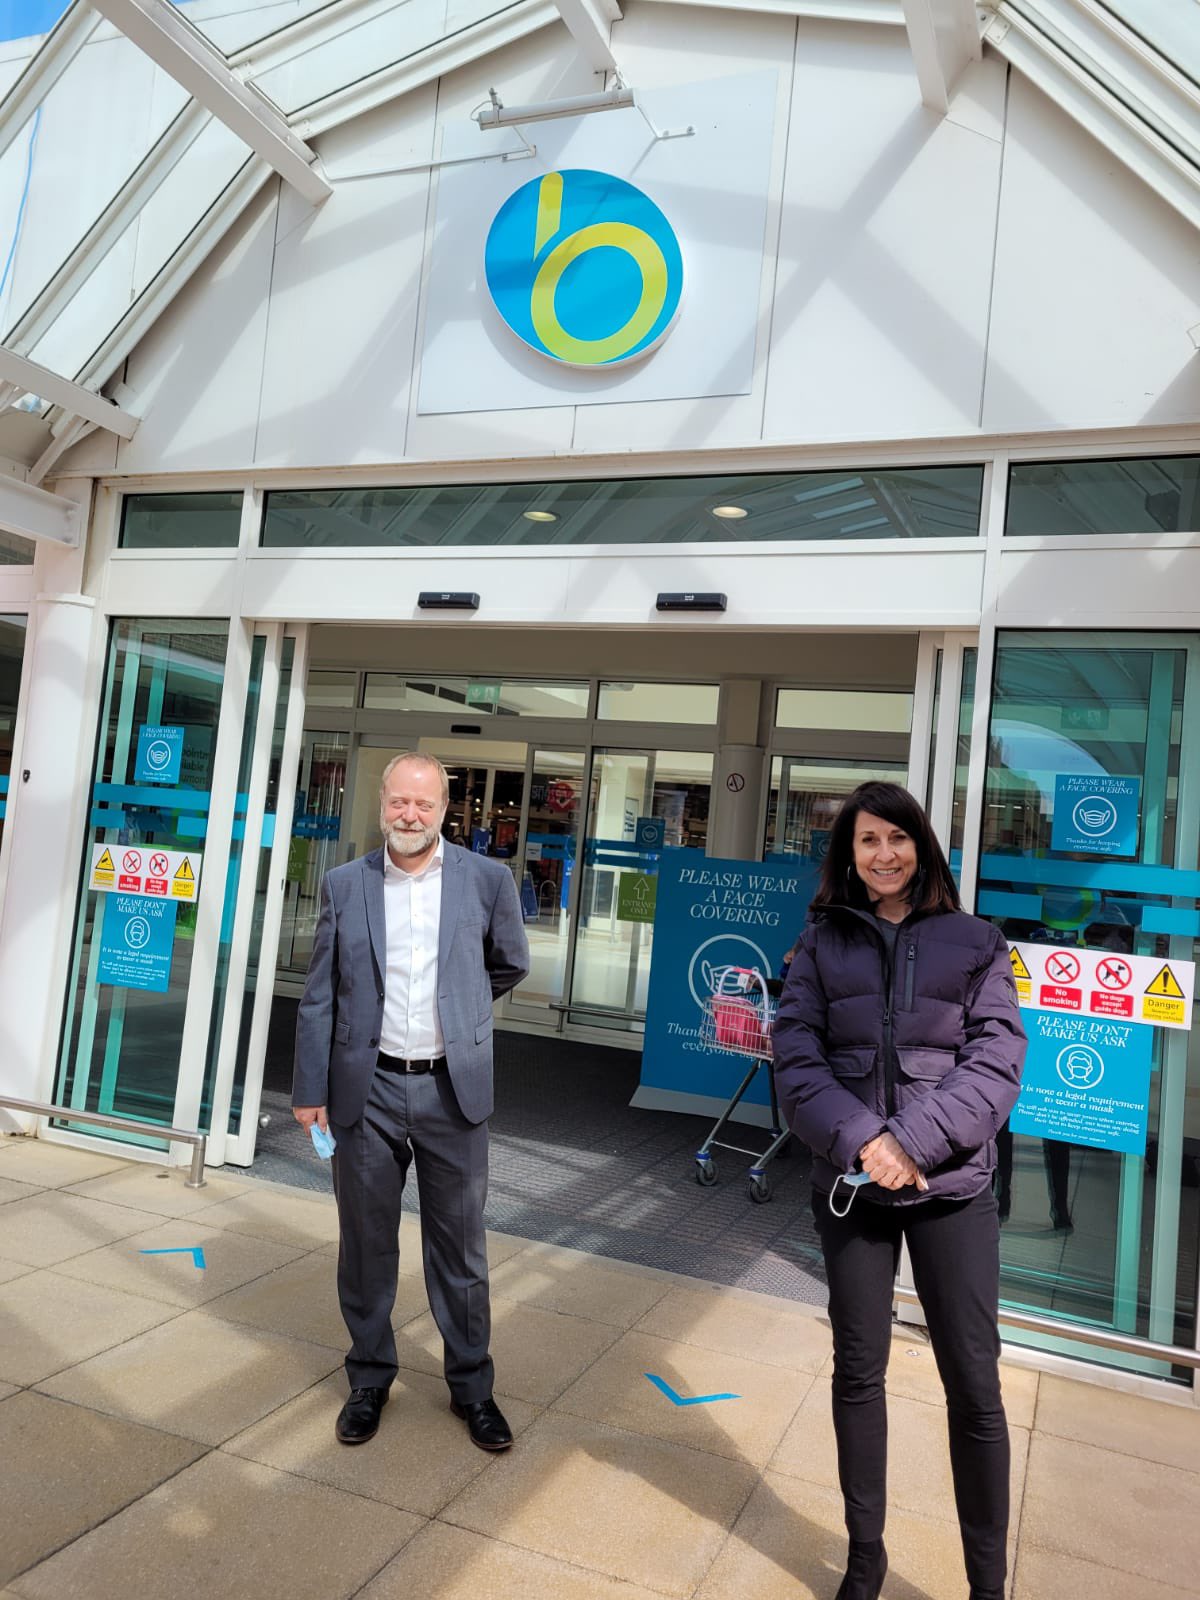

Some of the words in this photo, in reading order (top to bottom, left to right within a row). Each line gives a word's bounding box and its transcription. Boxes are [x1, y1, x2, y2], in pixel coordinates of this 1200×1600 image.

[1068, 778, 1099, 786] PLEASE
[1102, 779, 1126, 787] WEAR
[1090, 786, 1133, 794] COVERING
[678, 868, 742, 888] PLEASE
[747, 875, 799, 894] WEAR
[117, 897, 143, 908] PLEASE
[706, 889, 717, 903] A
[722, 890, 766, 908] FACE
[118, 905, 136, 914] MAKE
[690, 904, 780, 926] COVERING
[1055, 988, 1068, 997] No
[1043, 996, 1078, 1008] smoking
[1148, 999, 1180, 1010] Danger
[1037, 1015, 1086, 1032] PLEASE
[1090, 1022, 1132, 1038] DON'T
[1040, 1026, 1076, 1040] MAKE
[1080, 1032, 1097, 1044] US
[1100, 1036, 1127, 1048] ASK
[1026, 1084, 1034, 1092] is
[1036, 1087, 1054, 1096] now
[1065, 1090, 1086, 1101] legal
[1088, 1095, 1144, 1110] requirement
[1089, 1104, 1114, 1114] mask
